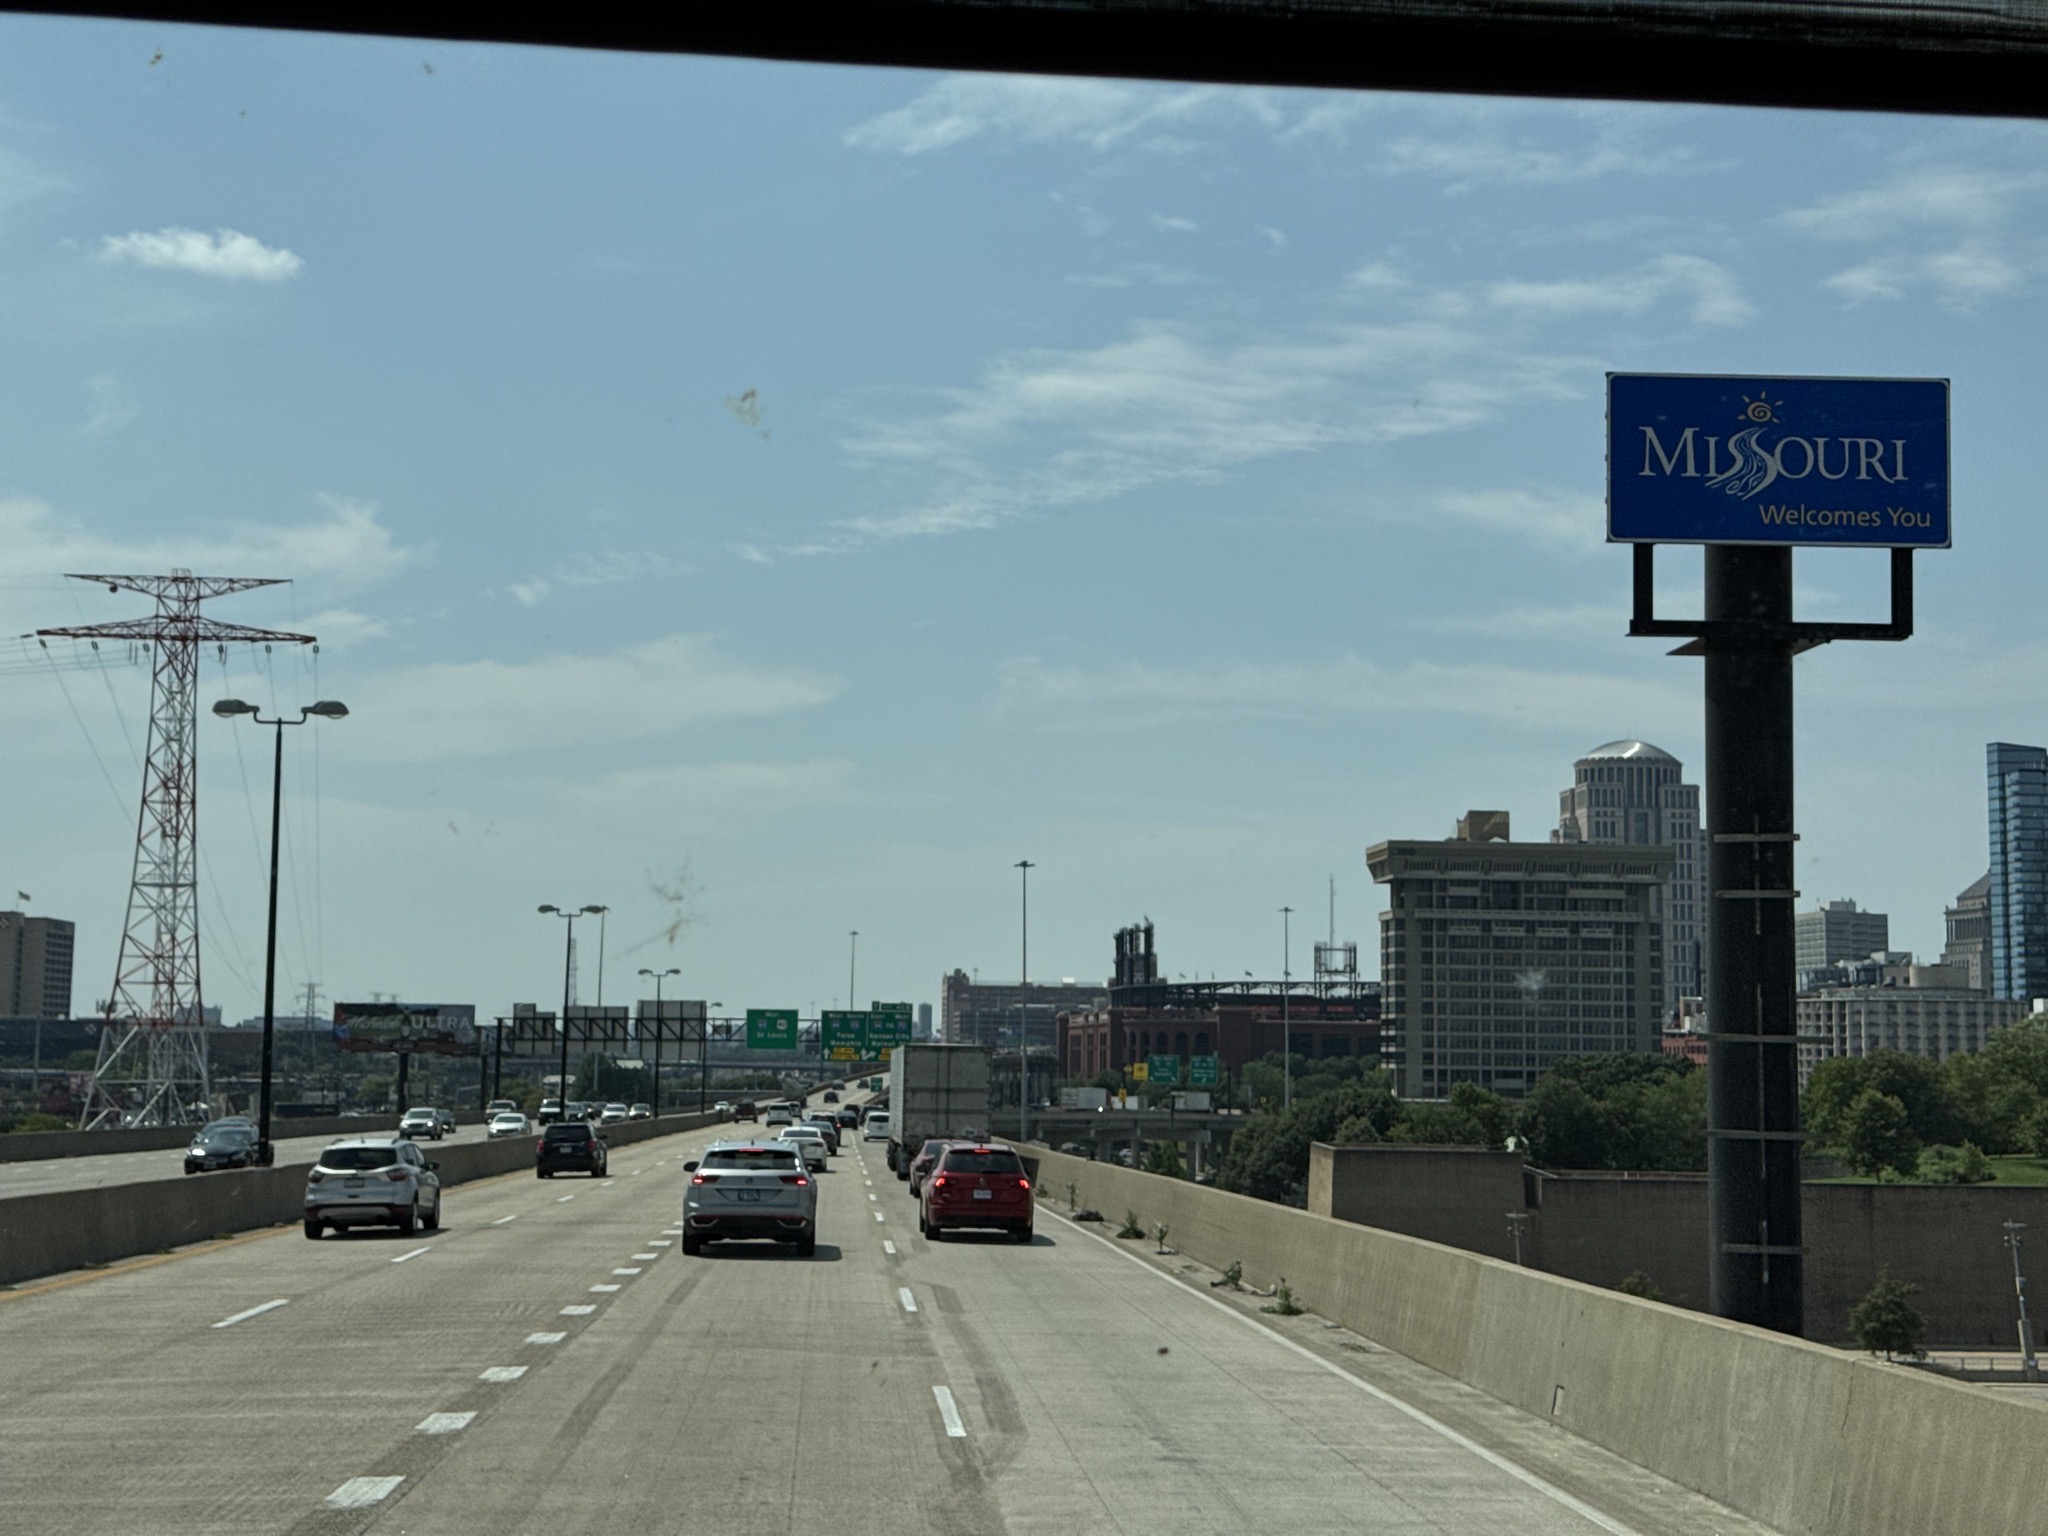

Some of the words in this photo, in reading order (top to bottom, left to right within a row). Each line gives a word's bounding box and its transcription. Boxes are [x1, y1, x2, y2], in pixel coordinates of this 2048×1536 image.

[1759, 504, 1881, 527] Welcomes
[1887, 507, 1931, 528] You
[411, 1016, 472, 1030] ULTRA
